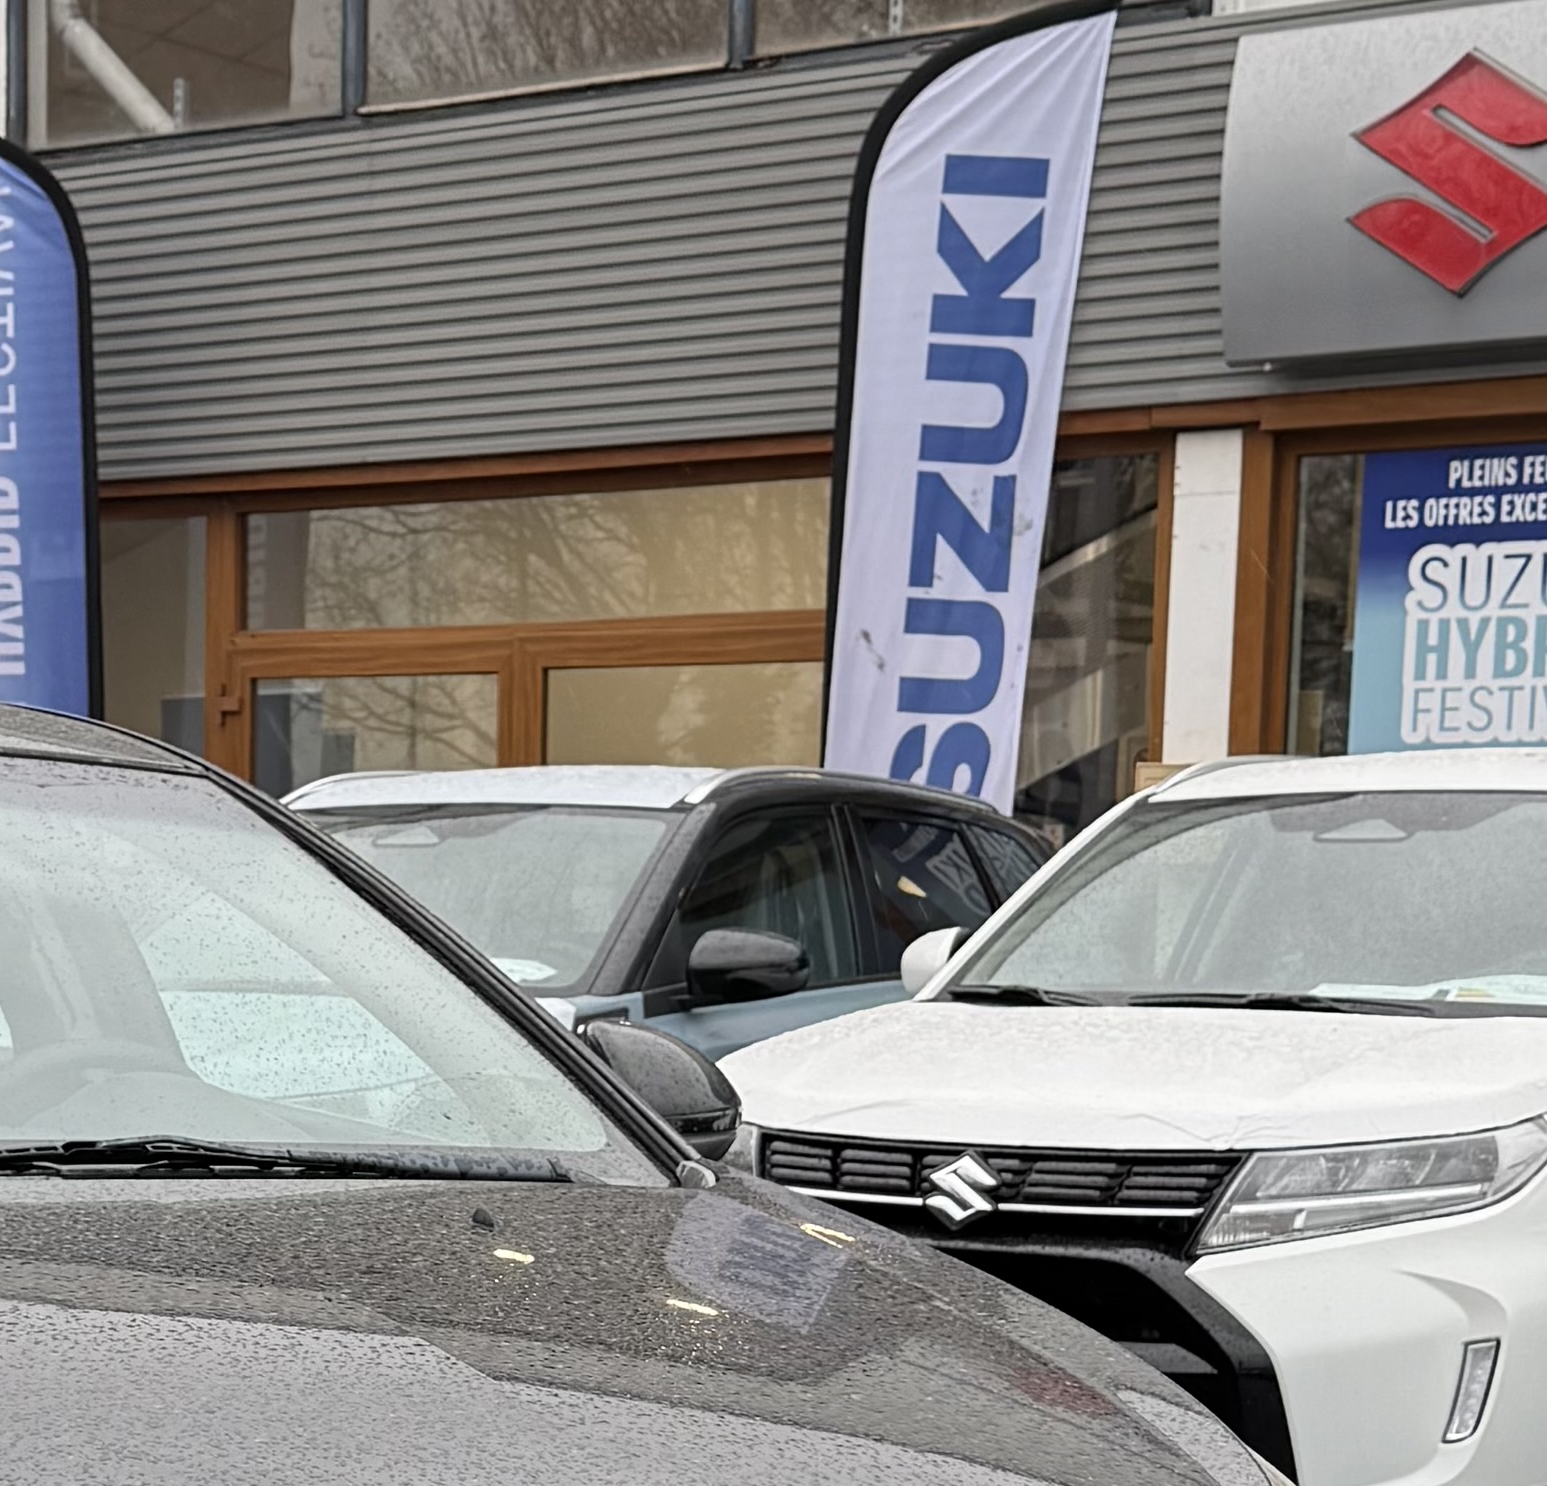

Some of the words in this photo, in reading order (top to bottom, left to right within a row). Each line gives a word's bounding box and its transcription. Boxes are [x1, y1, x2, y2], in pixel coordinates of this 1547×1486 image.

[889, 154, 1051, 799] SUZUKI
[1448, 456, 1518, 489] PLEINS
[1522, 454, 1547, 484] FE
[1384, 499, 1420, 529] LES
[1424, 495, 1495, 526] OFFRES
[1416, 552, 1547, 613] SUZ
[1412, 685, 1547, 733] FESTI
